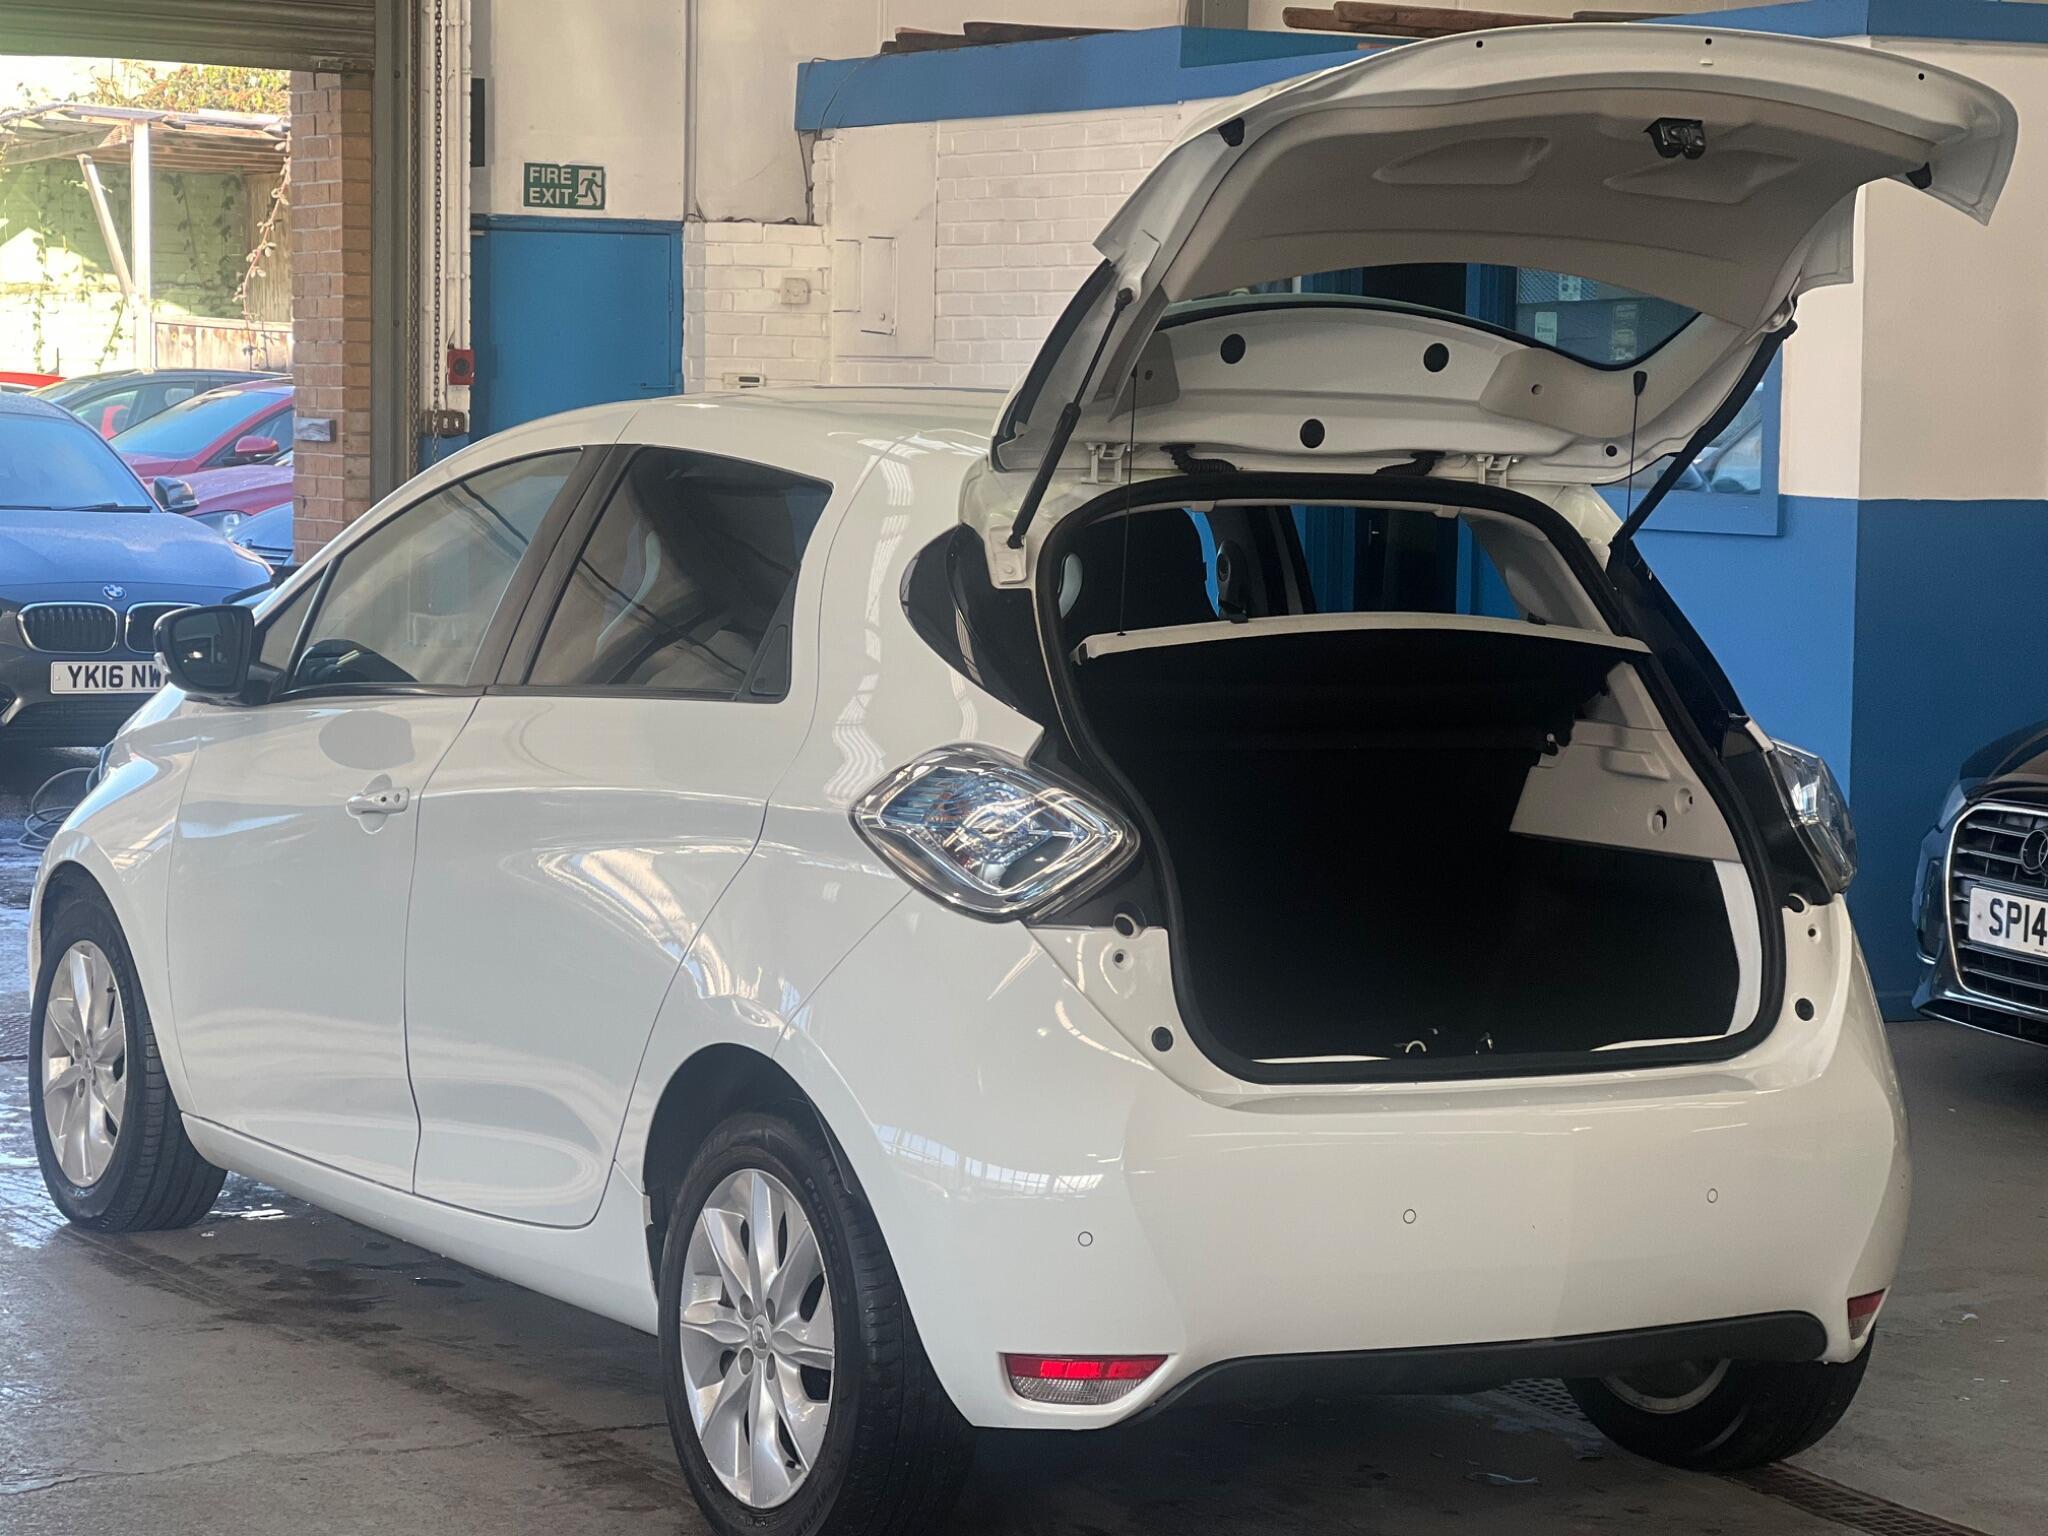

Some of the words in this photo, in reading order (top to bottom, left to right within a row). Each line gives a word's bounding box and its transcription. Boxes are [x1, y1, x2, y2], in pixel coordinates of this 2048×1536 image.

[529, 166, 572, 185] FIRE
[528, 187, 573, 205] EXIT
[67, 664, 124, 689] YK16
[131, 664, 167, 689] NW
[1989, 898, 2048, 946] SP14
